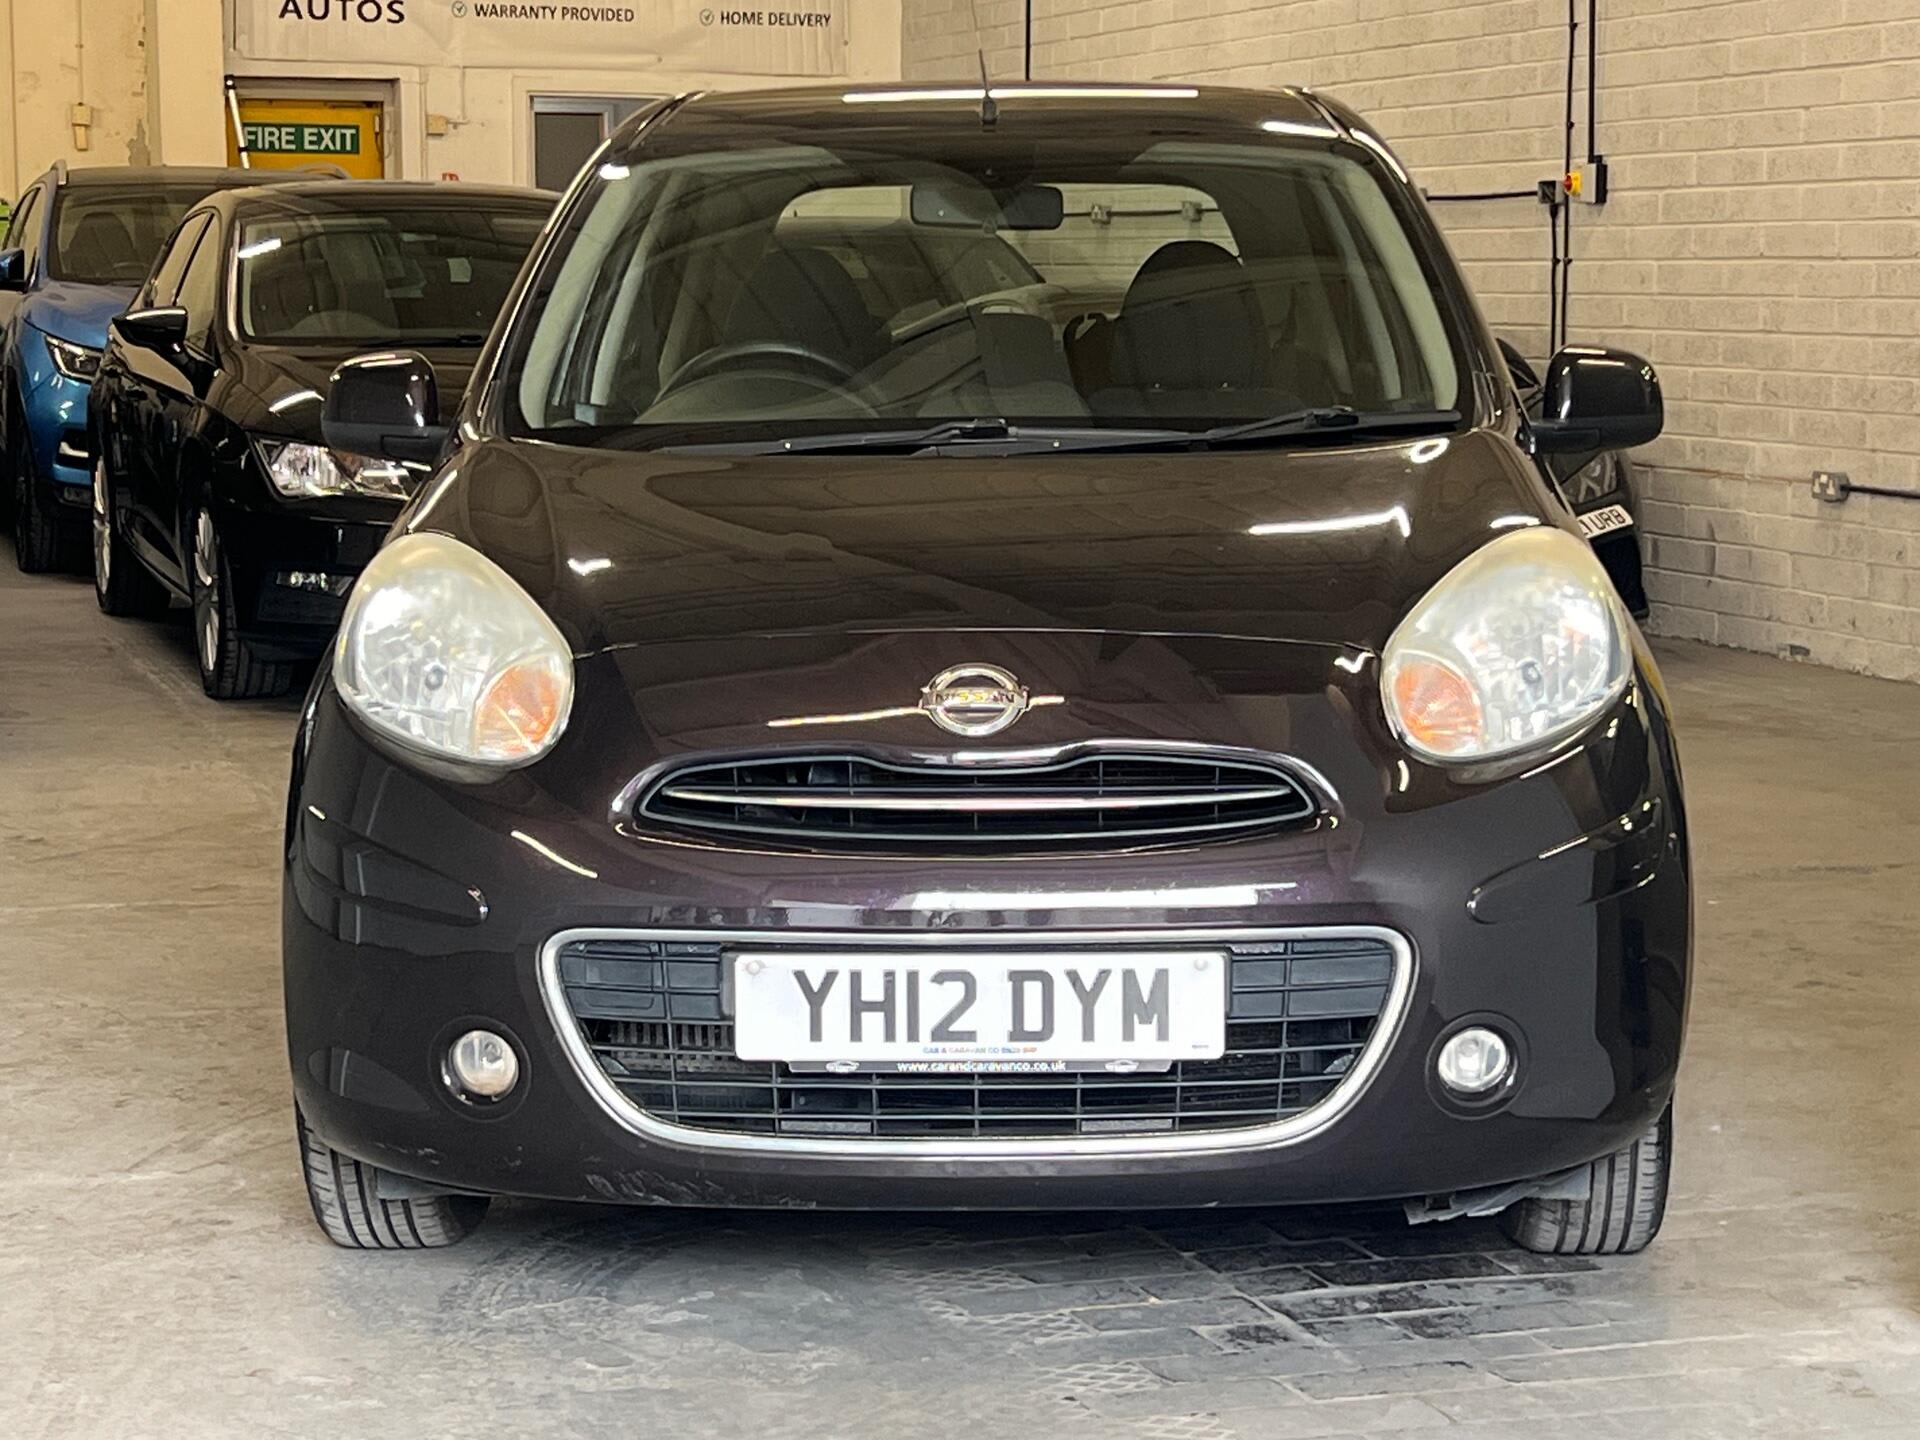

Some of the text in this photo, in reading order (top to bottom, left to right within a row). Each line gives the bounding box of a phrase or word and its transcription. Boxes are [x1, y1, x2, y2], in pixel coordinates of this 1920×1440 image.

[279, 0, 405, 24] AUTOS
[474, 4, 635, 22] WARRANTY PROVIDED
[720, 11, 831, 27] HOME DELIVERY
[244, 126, 357, 151] FIRE EXIT
[1588, 509, 1626, 531] URB
[792, 969, 1170, 1043] YH12 DYM
[897, 1059, 1066, 1073] www.carandcaravanco.co.uk
